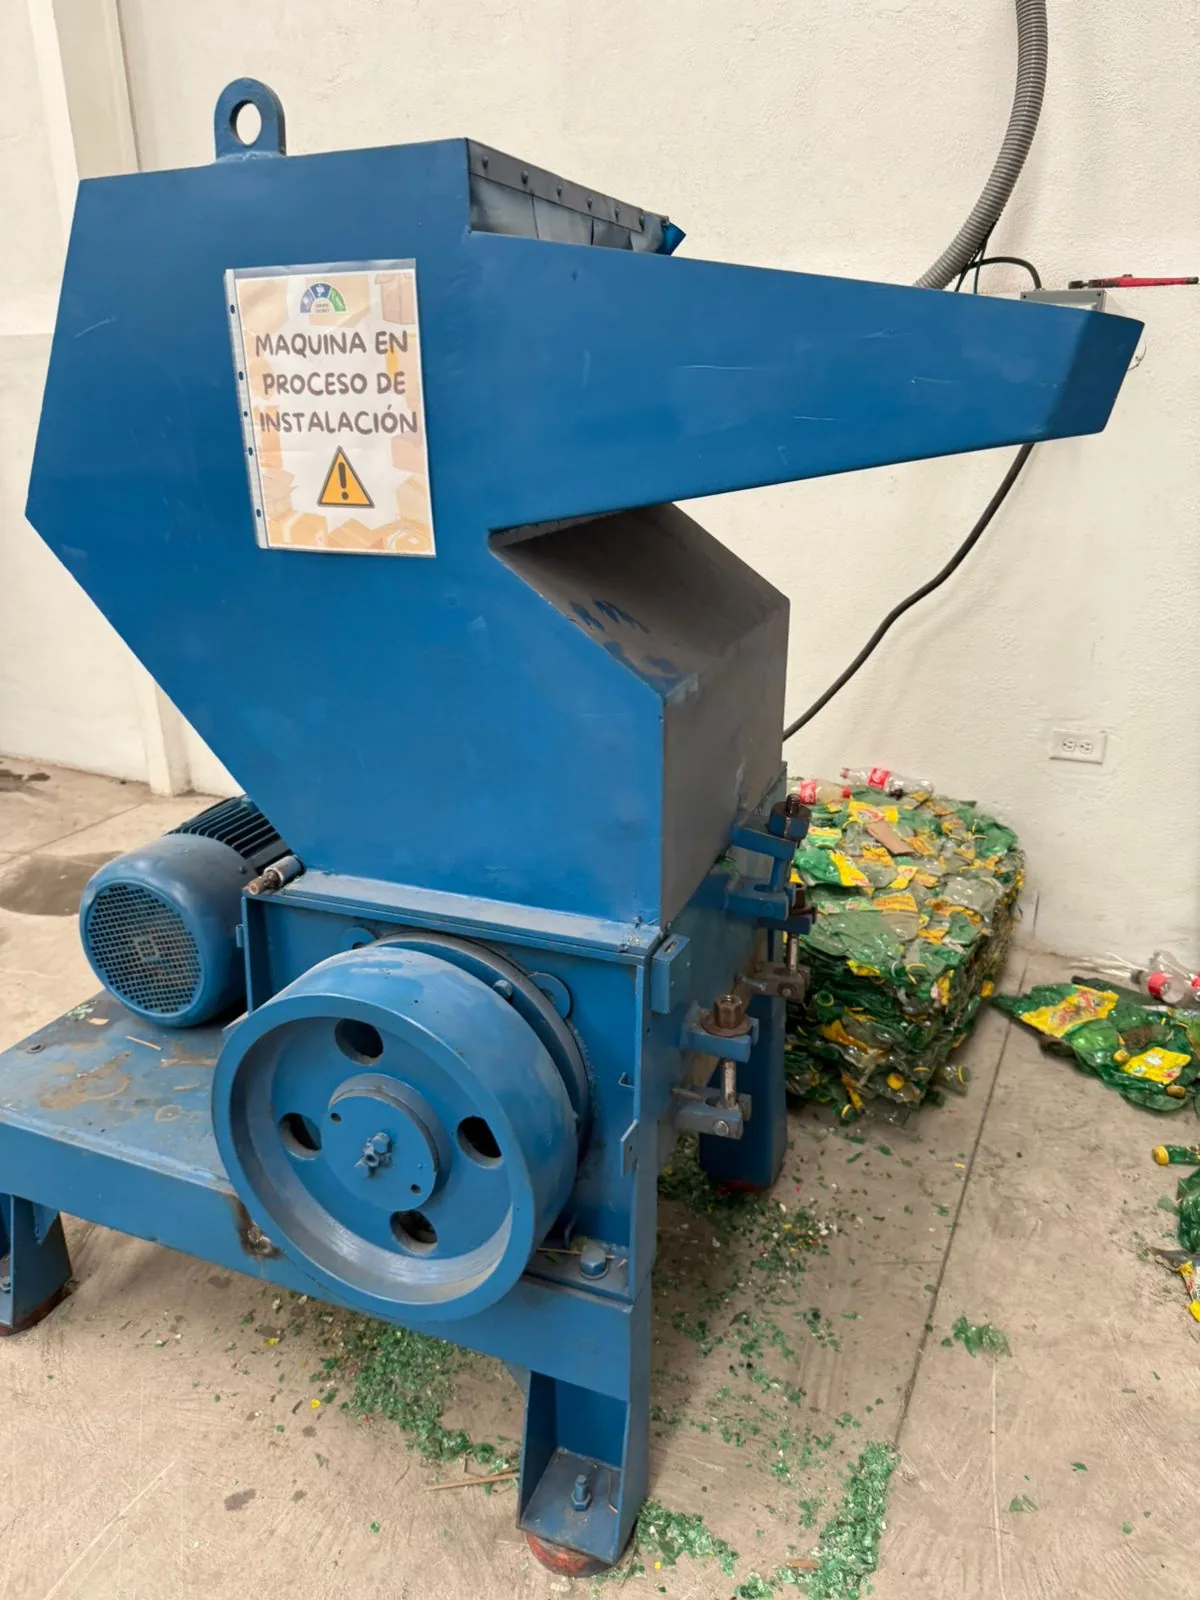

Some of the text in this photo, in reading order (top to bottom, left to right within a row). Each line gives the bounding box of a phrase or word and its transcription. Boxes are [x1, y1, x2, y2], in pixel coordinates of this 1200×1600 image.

[255, 330, 408, 357] MAQUINA EN
[263, 371, 406, 395] PROCESO DE
[260, 404, 418, 434] INSTALACIÓN
